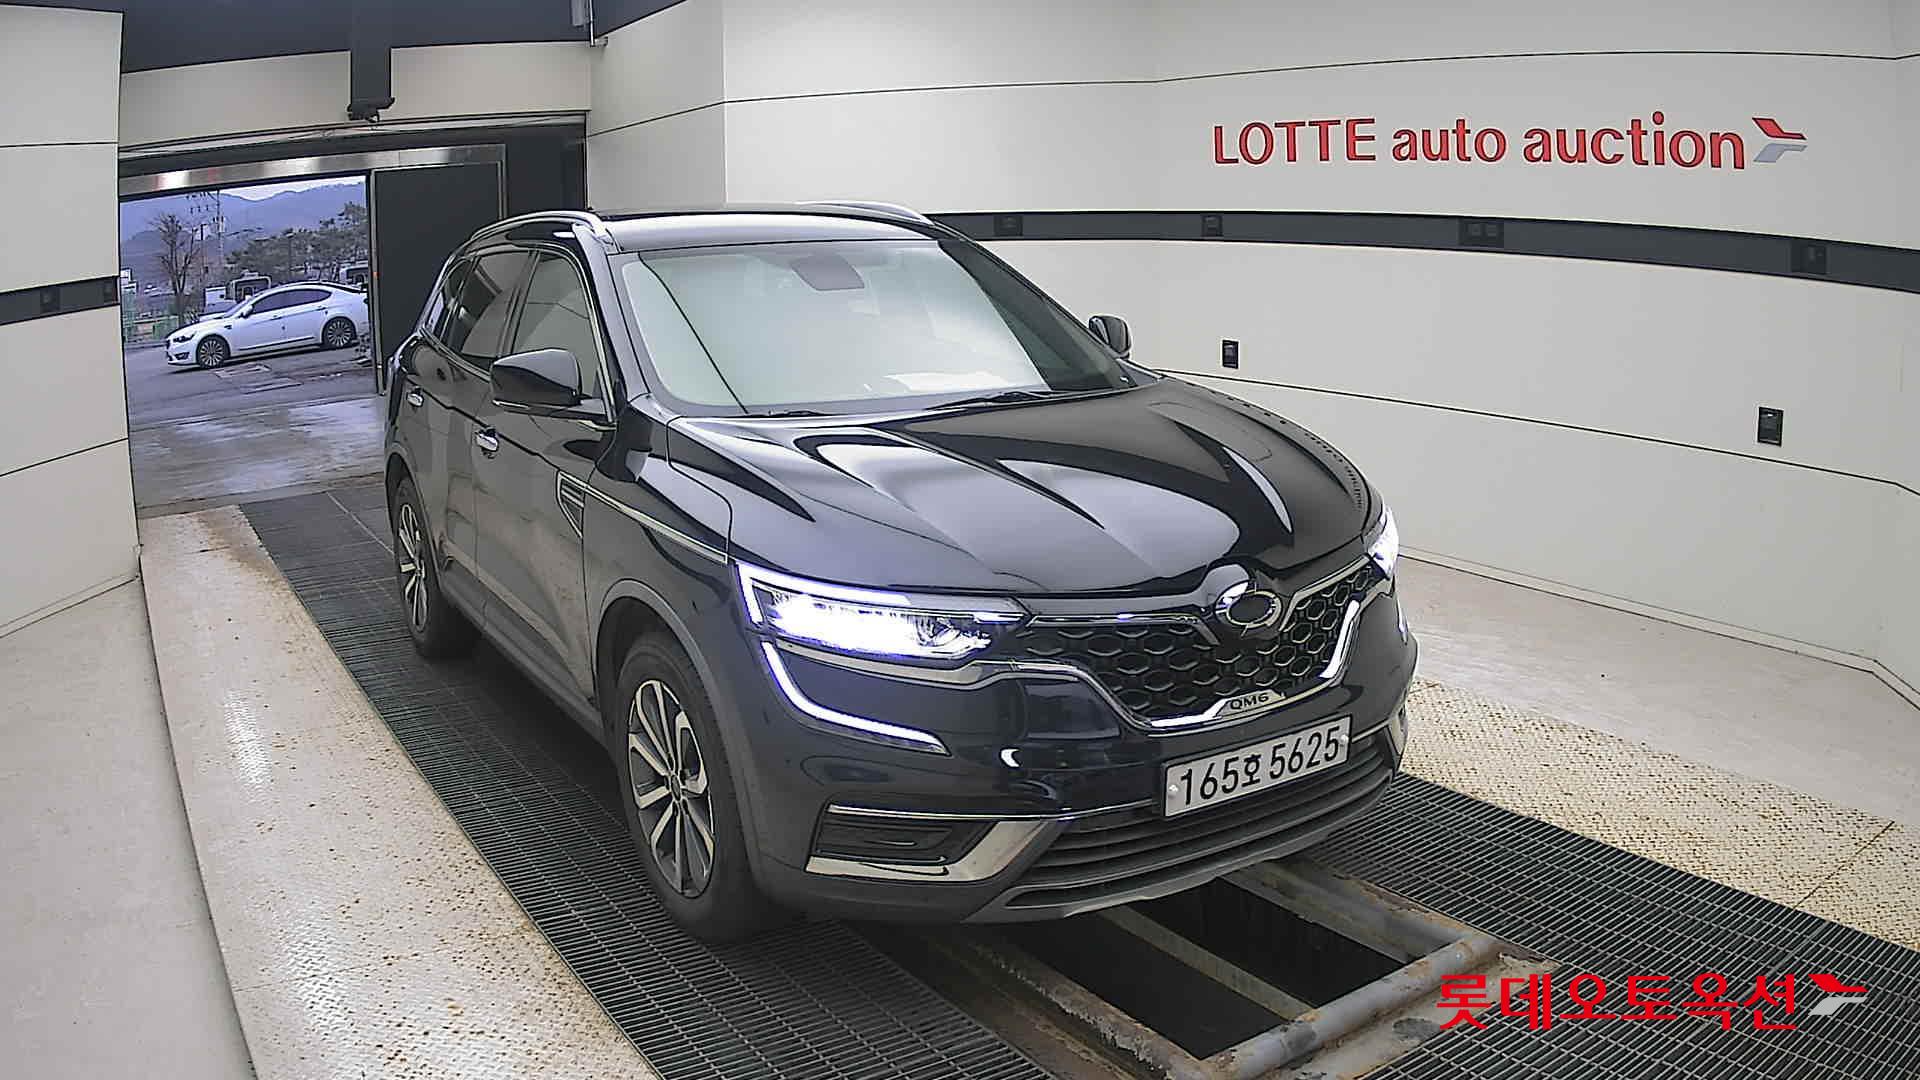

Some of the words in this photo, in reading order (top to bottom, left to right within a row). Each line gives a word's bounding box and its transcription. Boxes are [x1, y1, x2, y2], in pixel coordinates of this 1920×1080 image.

[1212, 117, 1377, 165] LOTTE
[1392, 118, 1507, 163] auto
[1523, 111, 1745, 170] auction
[1230, 694, 1270, 711] QM6
[1269, 726, 1340, 780] 5625
